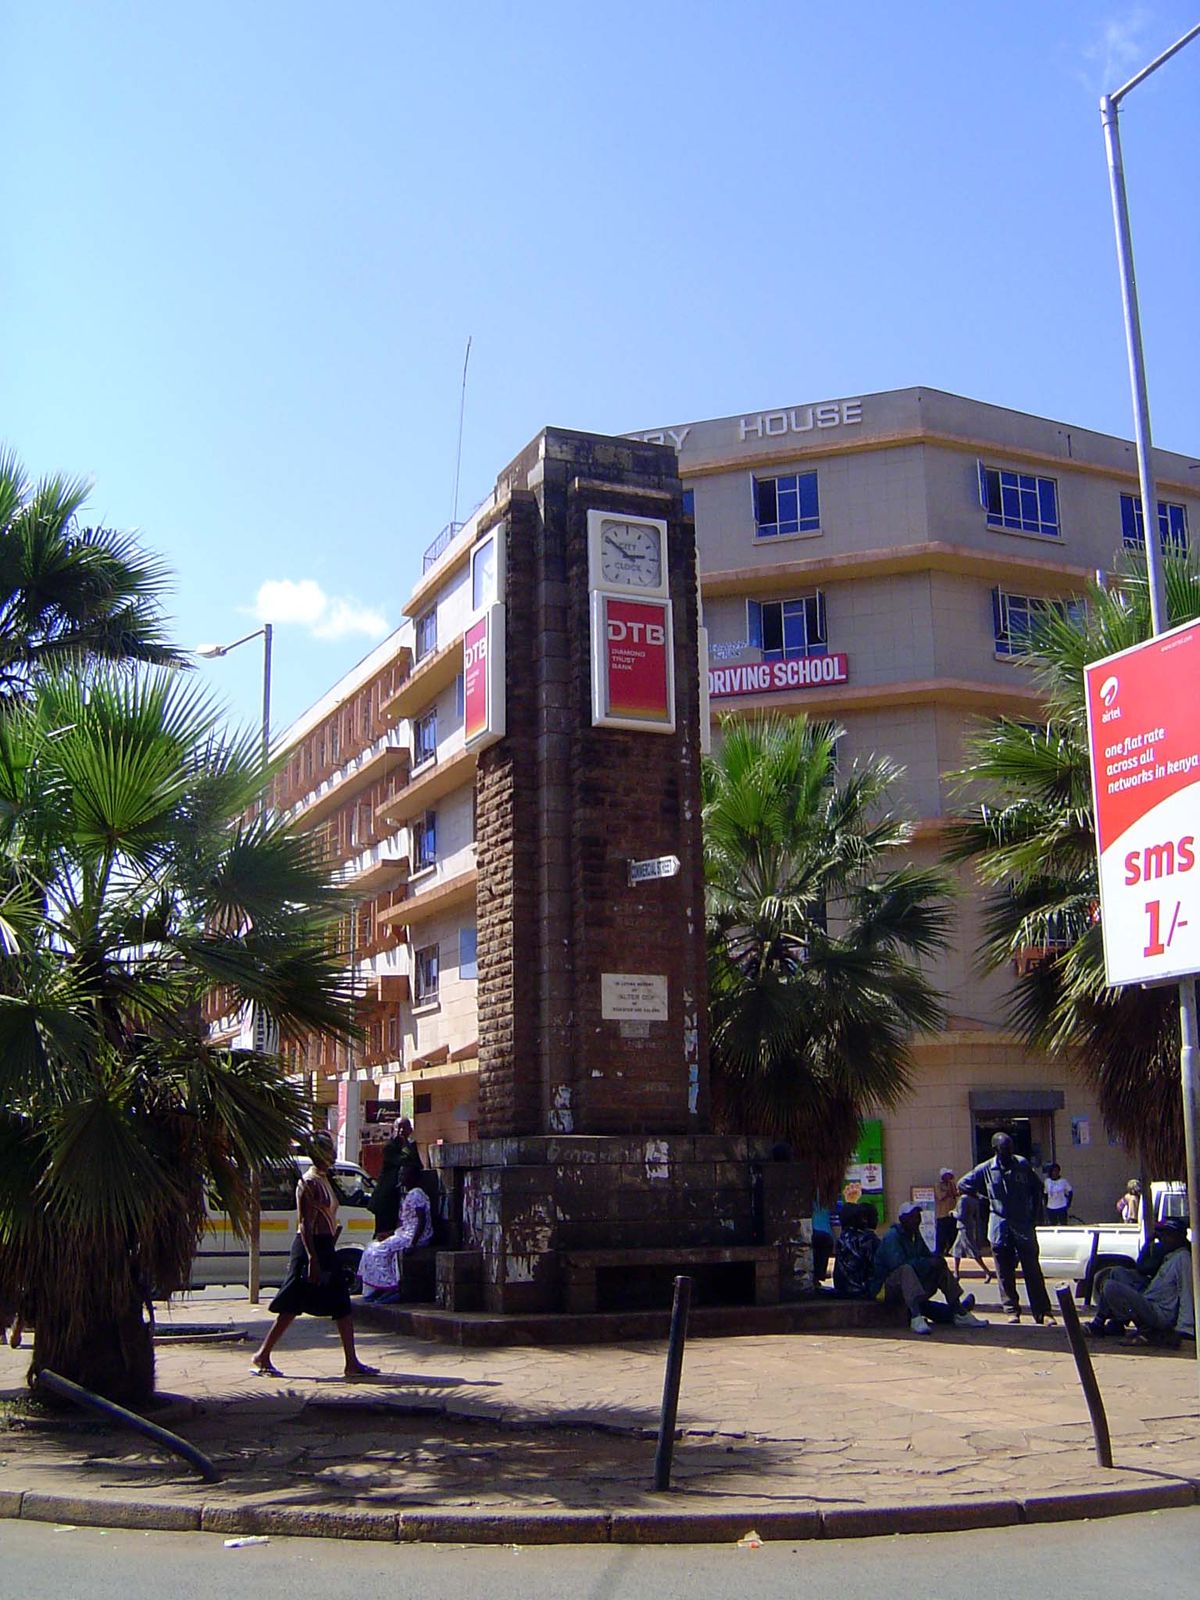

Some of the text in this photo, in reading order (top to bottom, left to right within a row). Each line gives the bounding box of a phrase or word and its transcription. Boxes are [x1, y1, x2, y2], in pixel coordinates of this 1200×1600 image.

[740, 400, 862, 440] HOUSE
[619, 542, 637, 550] CITY
[615, 562, 641, 571] CLOCK
[608, 619, 665, 646] DTB
[465, 636, 487, 669] DTB
[611, 649, 646, 657] DIAMOND
[611, 662, 632, 671] BANK
[612, 656, 635, 664] TRUST
[773, 657, 847, 687] SCHOOL
[1102, 707, 1121, 723] airtel
[1105, 727, 1165, 758] one flat rate
[1106, 748, 1154, 776] across all
[1108, 753, 1199, 794] networks in kenya
[1125, 836, 1195, 886] sms
[1144, 900, 1188, 957] 1/-
